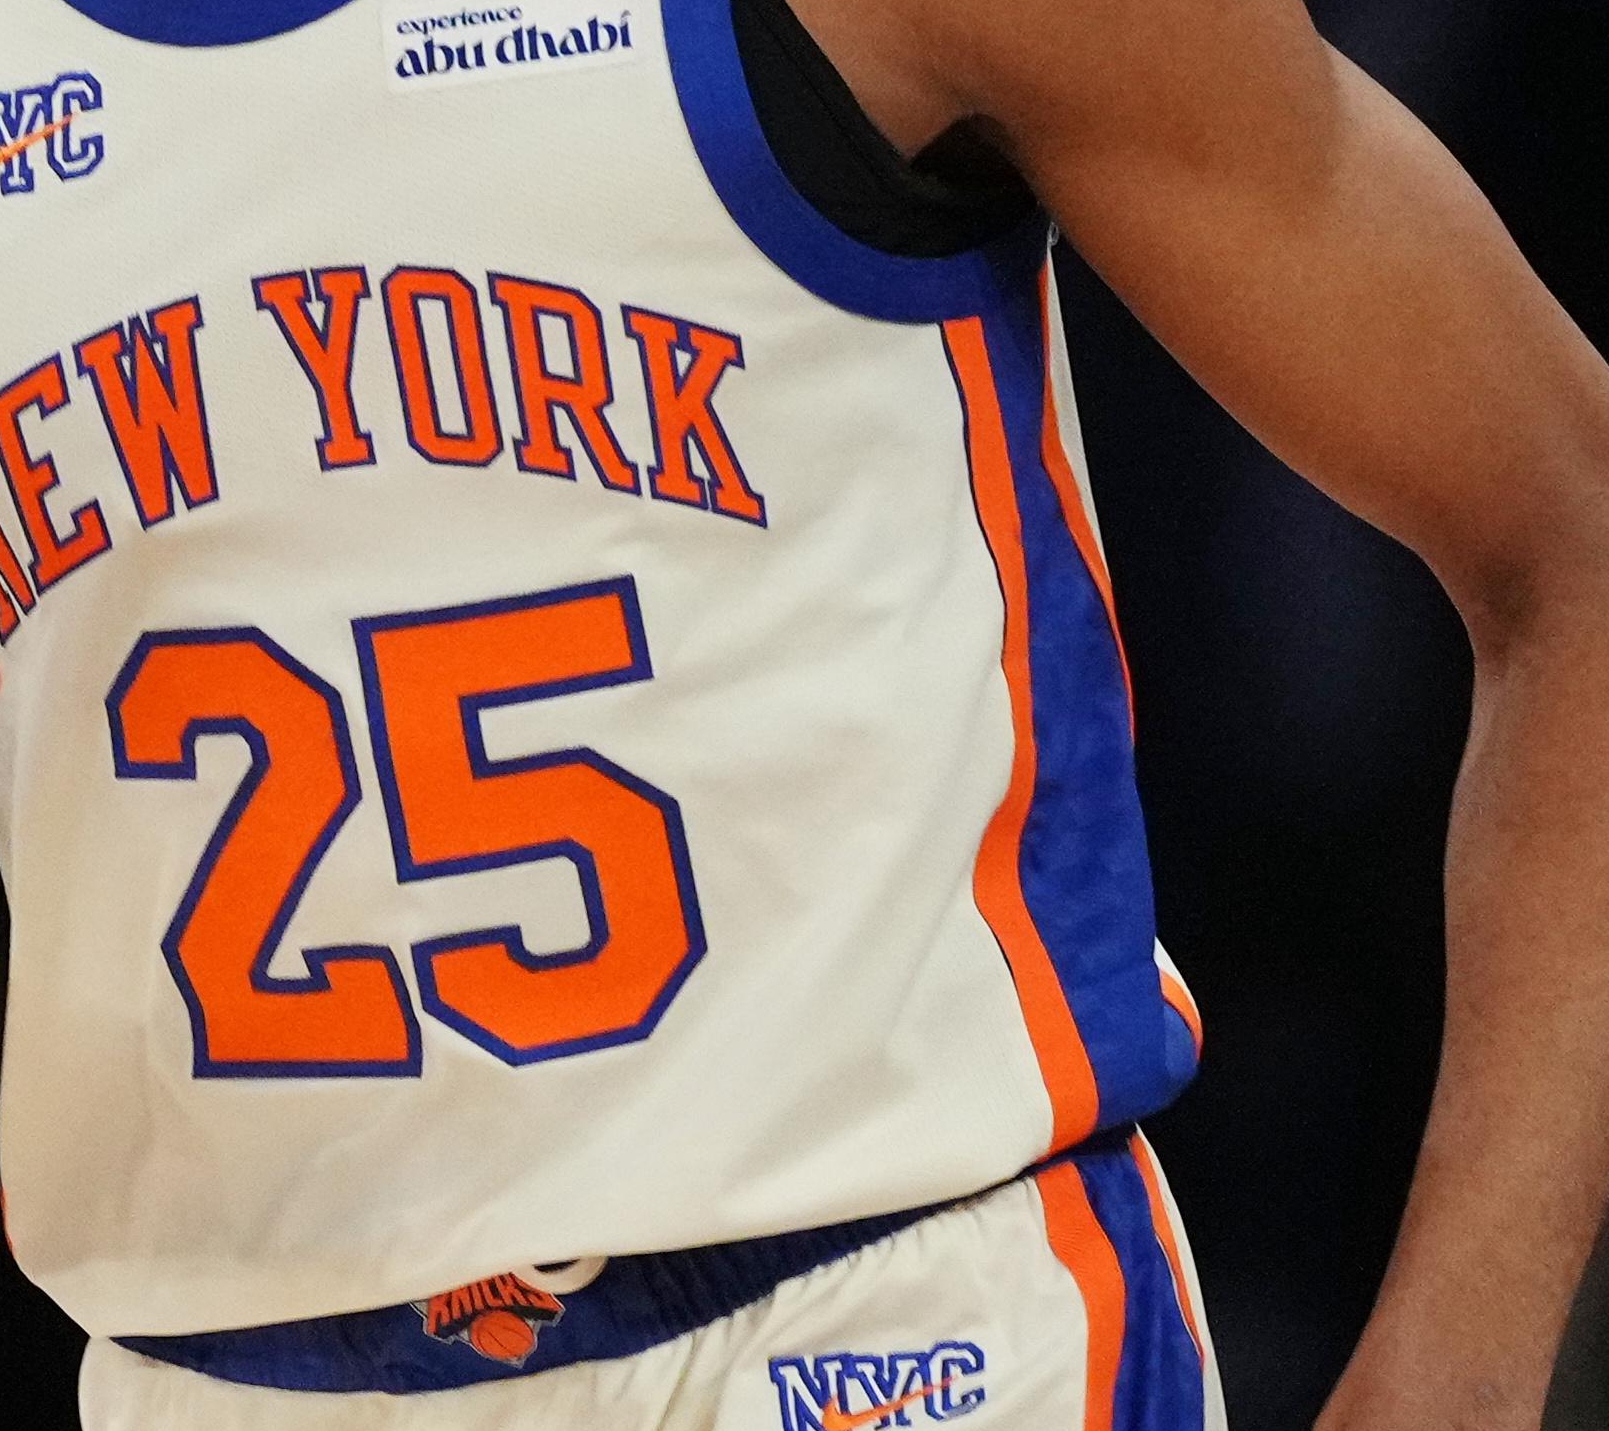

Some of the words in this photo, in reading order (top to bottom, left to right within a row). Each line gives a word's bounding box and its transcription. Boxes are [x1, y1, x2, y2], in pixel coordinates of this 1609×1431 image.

[395, 37, 486, 78] abu
[495, 10, 632, 65] dhabi
[396, 5, 522, 35] experience
[250, 264, 768, 528] YORK
[105, 574, 708, 1078] 25
[428, 1271, 564, 1335] KNICKS
